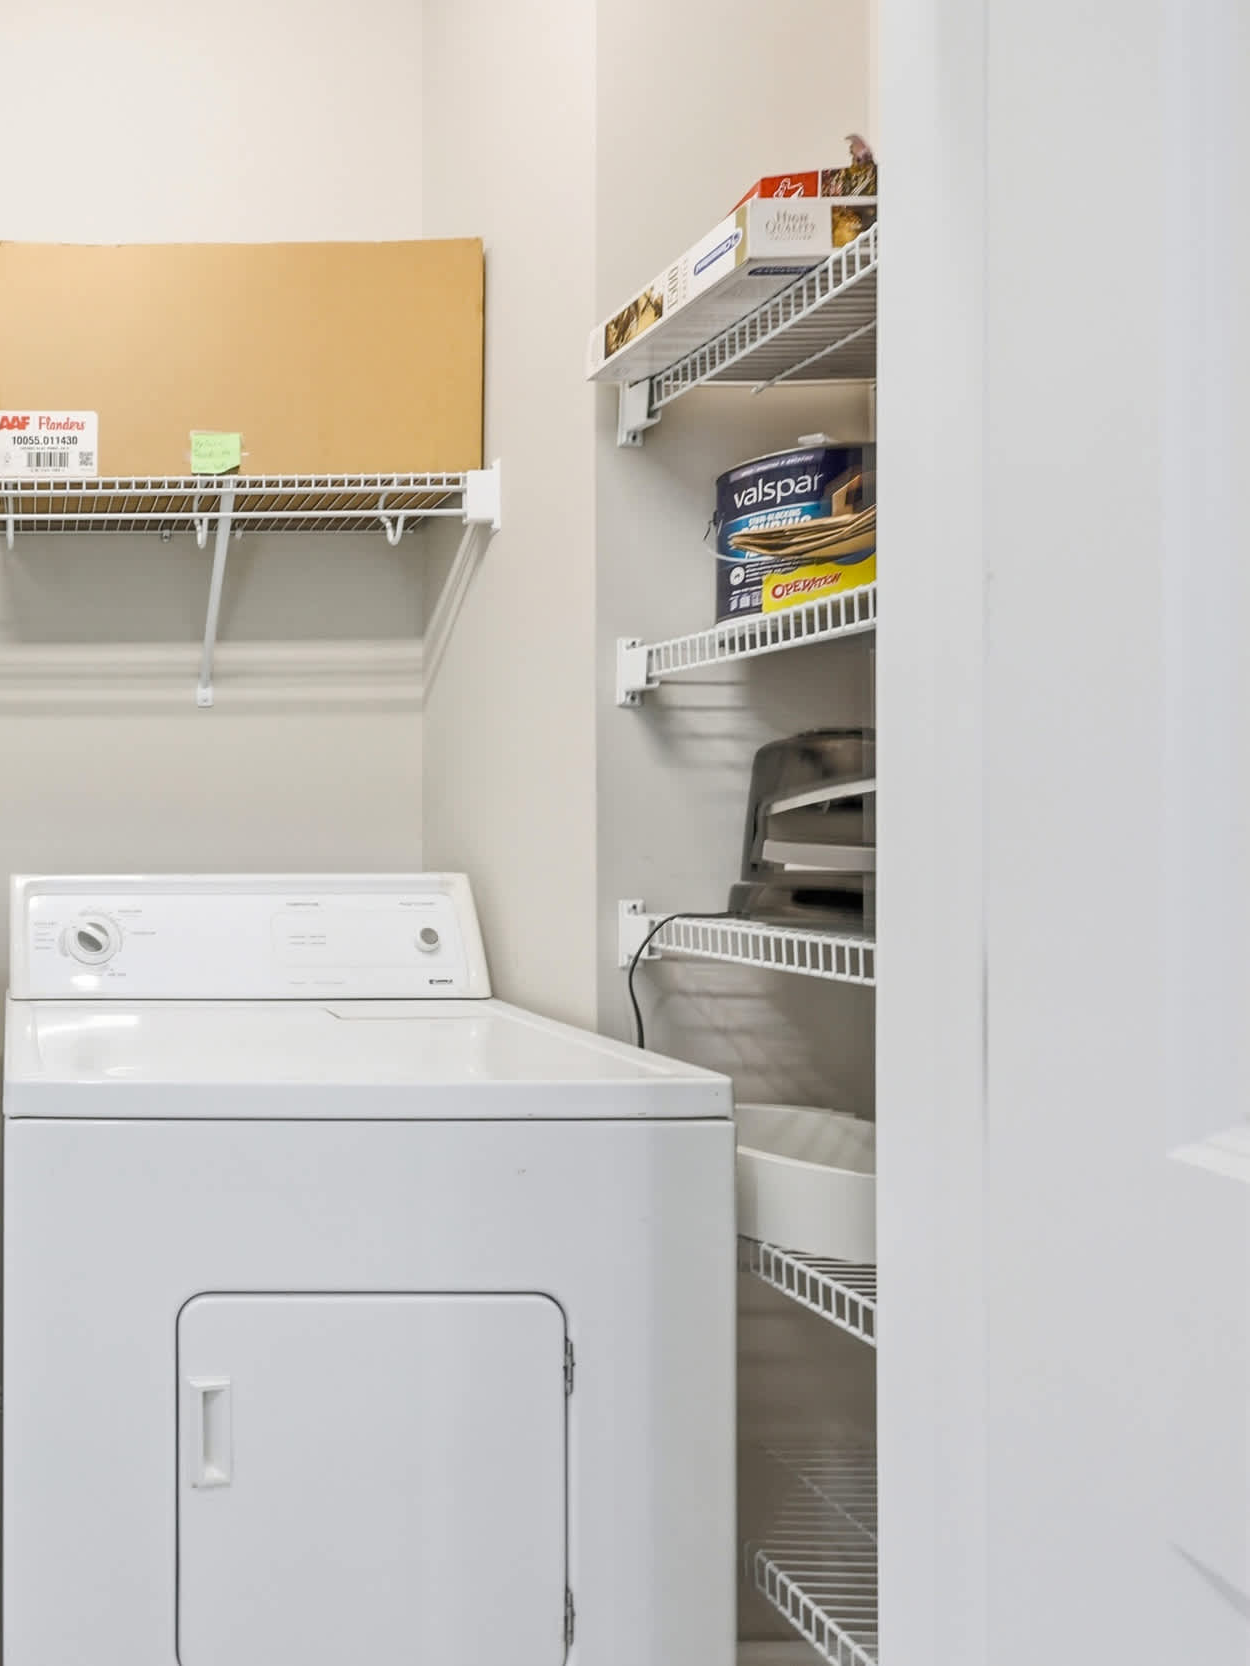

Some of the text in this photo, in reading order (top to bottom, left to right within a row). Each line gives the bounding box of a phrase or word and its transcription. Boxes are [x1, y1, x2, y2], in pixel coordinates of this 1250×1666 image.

[38, 415, 85, 431] Flanders
[12, 435, 78, 446] 10055.011430
[733, 473, 824, 509] valspar
[771, 572, 842, 599] OPERATION
